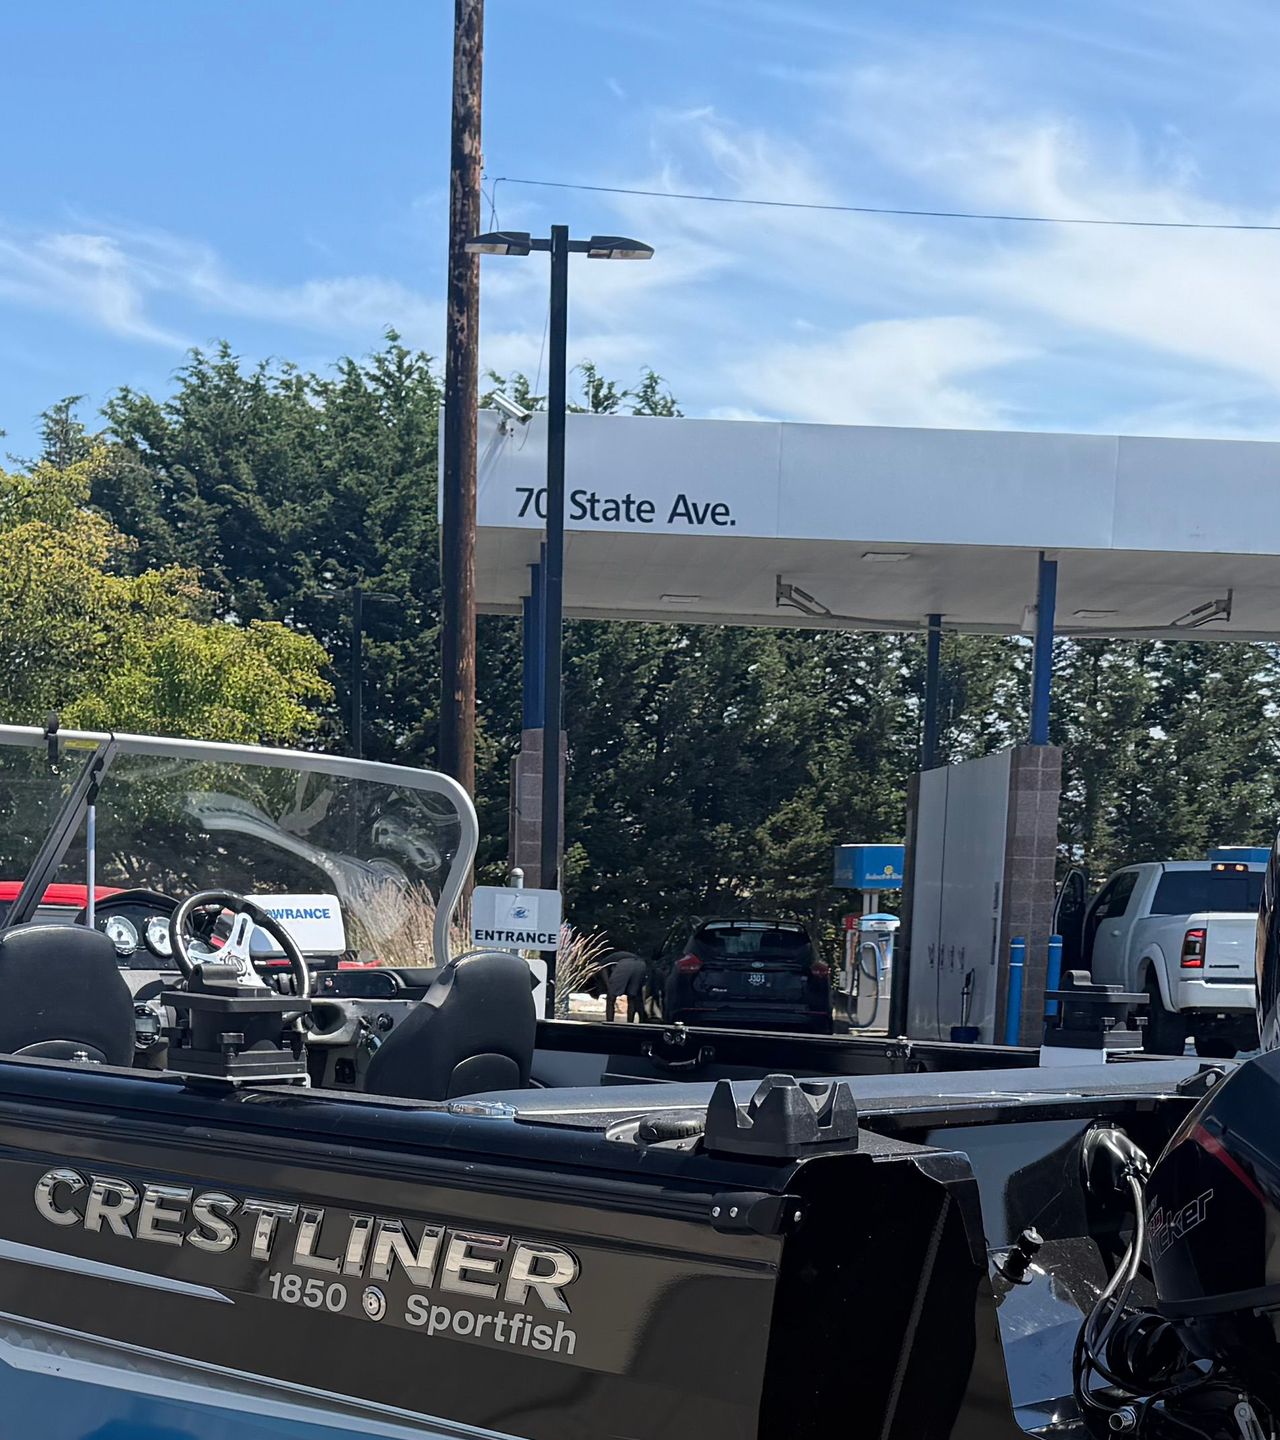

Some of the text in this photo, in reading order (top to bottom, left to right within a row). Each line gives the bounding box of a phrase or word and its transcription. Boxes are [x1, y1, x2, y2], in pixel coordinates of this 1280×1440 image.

[570, 489, 656, 523] State
[667, 494, 736, 526] Ave.
[264, 908, 331, 919] OWRANCE
[475, 929, 557, 944] ENTRANCE
[33, 1166, 581, 1314] CRESTLINER
[268, 1271, 577, 1356] 1850 Sportfish
